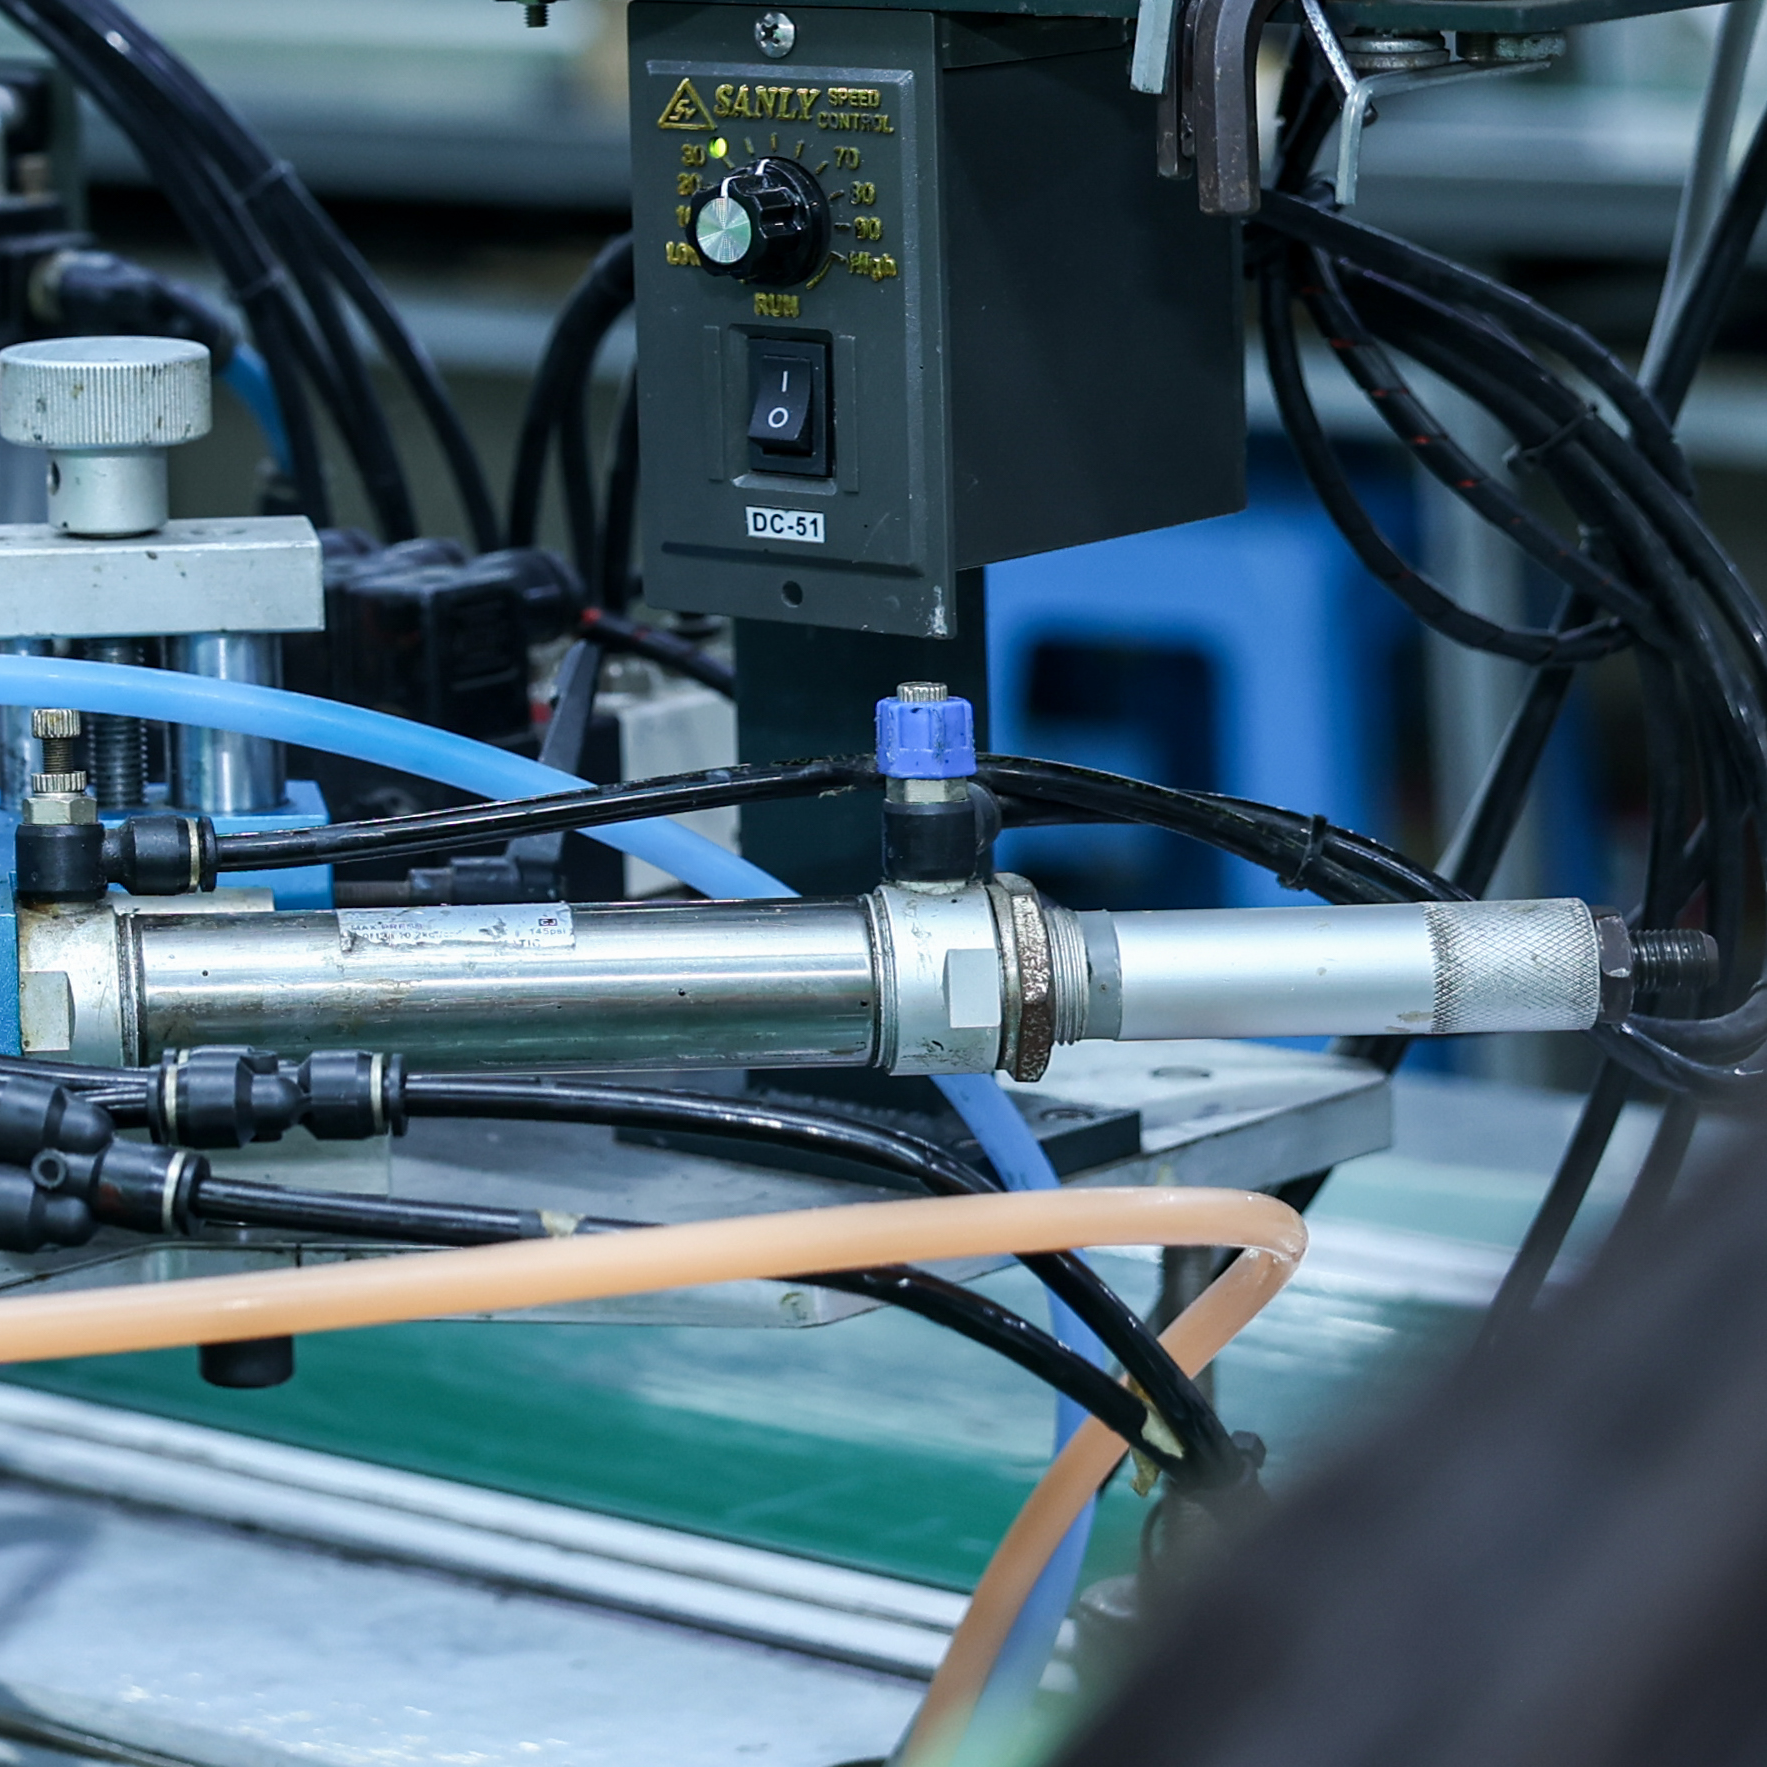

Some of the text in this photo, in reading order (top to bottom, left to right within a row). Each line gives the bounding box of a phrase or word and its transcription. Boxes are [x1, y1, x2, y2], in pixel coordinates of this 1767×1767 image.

[714, 83, 822, 121] SANLY
[826, 86, 882, 109] SPEED
[816, 111, 895, 134] CONTROL
[681, 143, 706, 167] 30
[833, 146, 861, 170] 70
[853, 216, 883, 241] 90
[754, 292, 800, 319] RUN
[752, 512, 819, 537] DC-51
